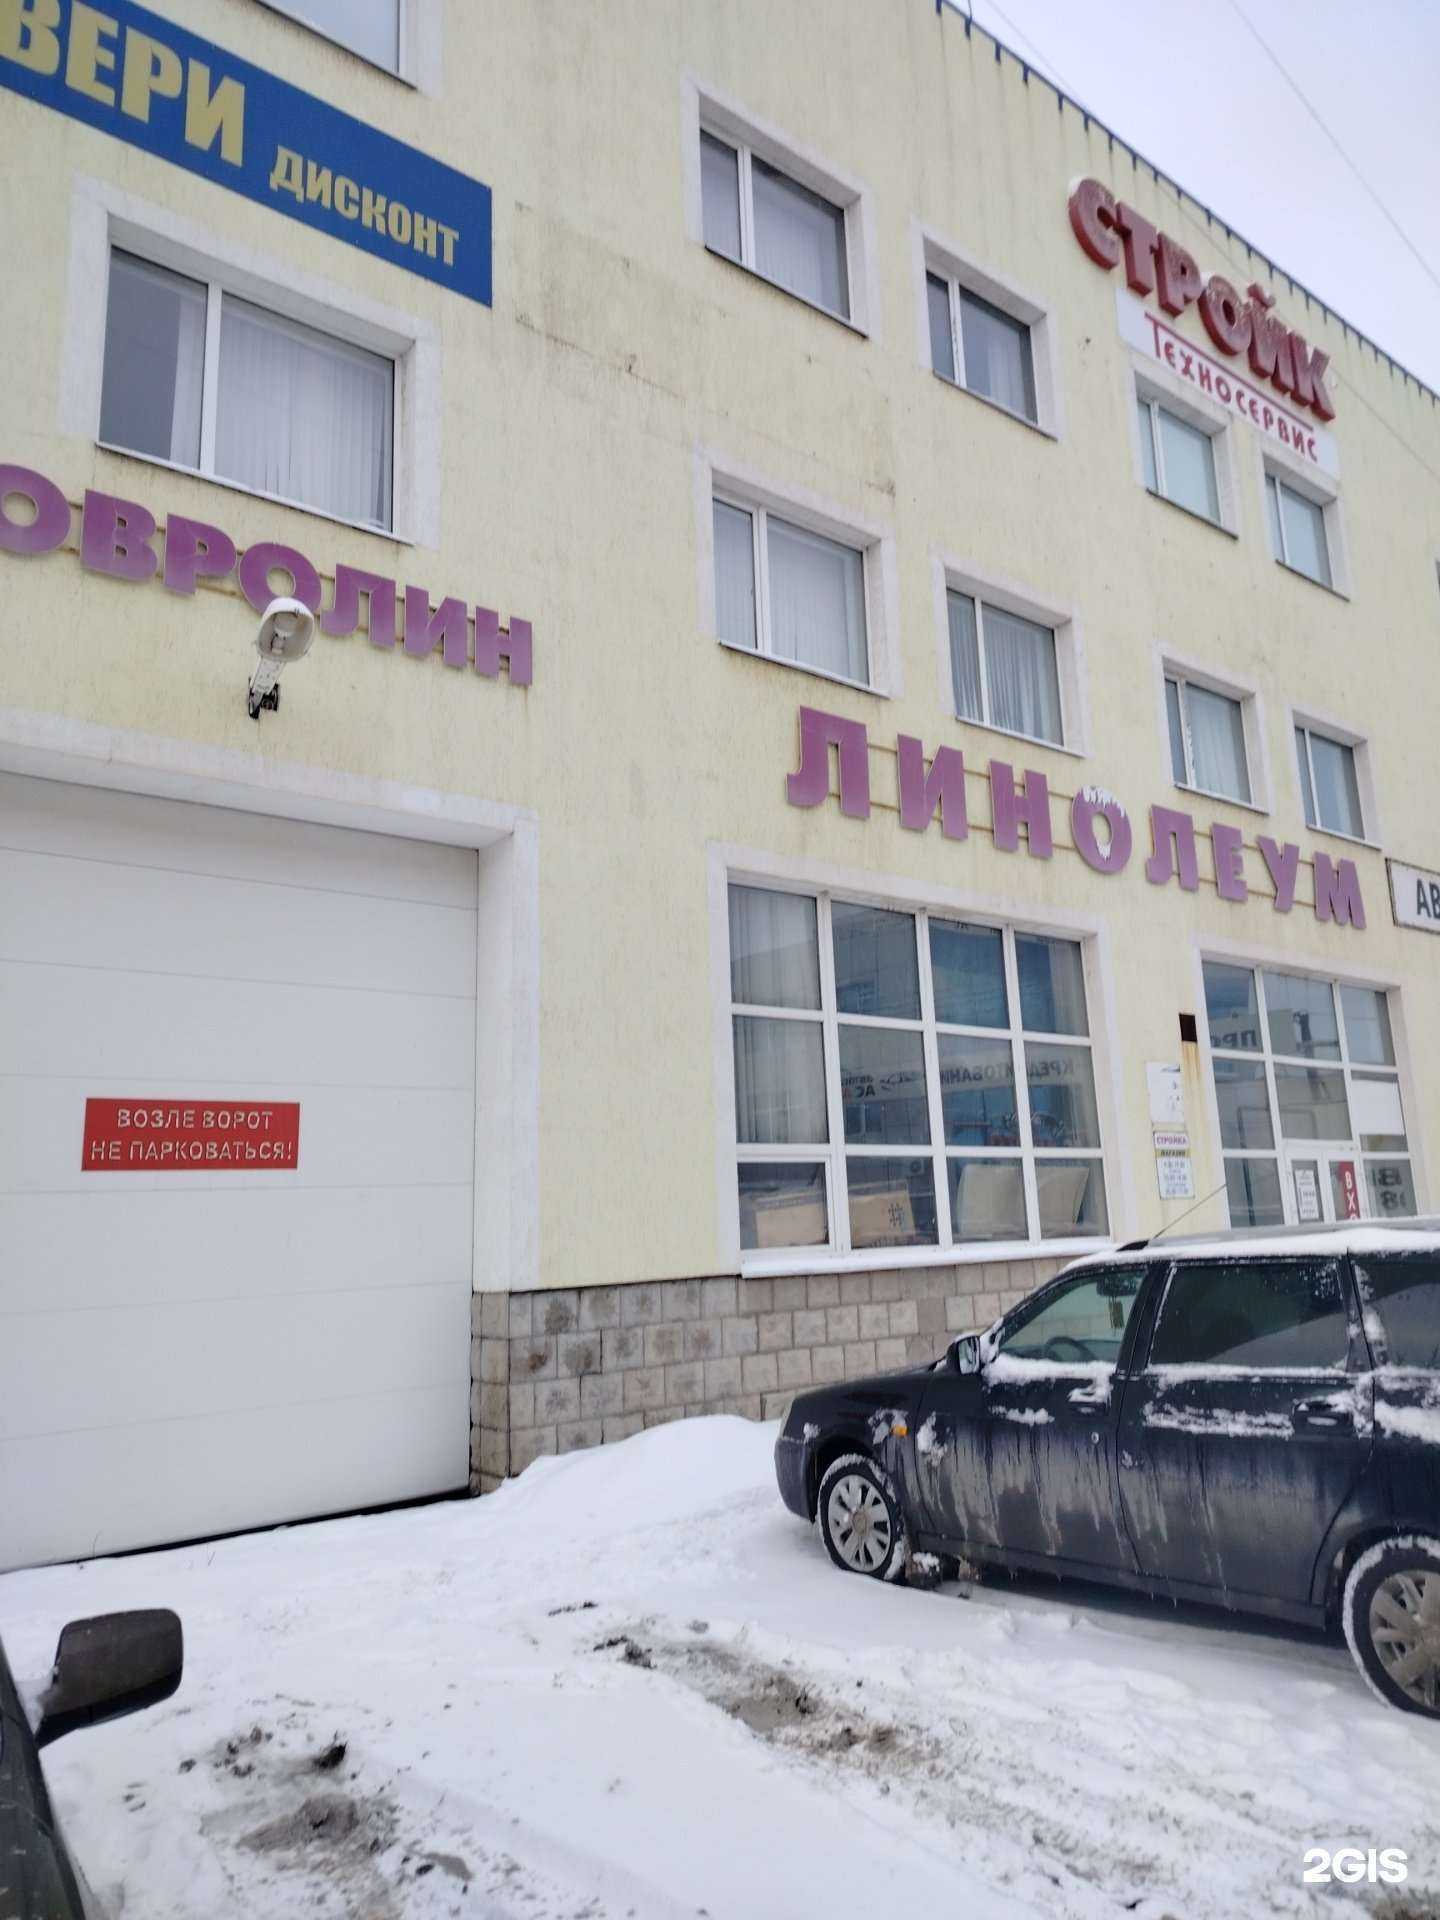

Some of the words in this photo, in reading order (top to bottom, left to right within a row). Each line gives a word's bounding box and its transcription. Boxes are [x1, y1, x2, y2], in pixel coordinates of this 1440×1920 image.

[0, 0, 245, 168] ВЕРИ
[269, 144, 459, 266] ДИСКОНТ
[1068, 178, 1335, 423] СТРОЙК
[0, 463, 533, 687] ОВРОЛИН
[786, 705, 1367, 930] ЛИНОЛЕУМ
[1416, 878, 1440, 918] АВ
[91, 1140, 121, 1160] НЕ
[129, 1140, 292, 1160] ПАРКОВАТЬСЯ!
[117, 1108, 195, 1128] ВОЗЛЕ
[202, 1111, 272, 1129] ВОРОТ
